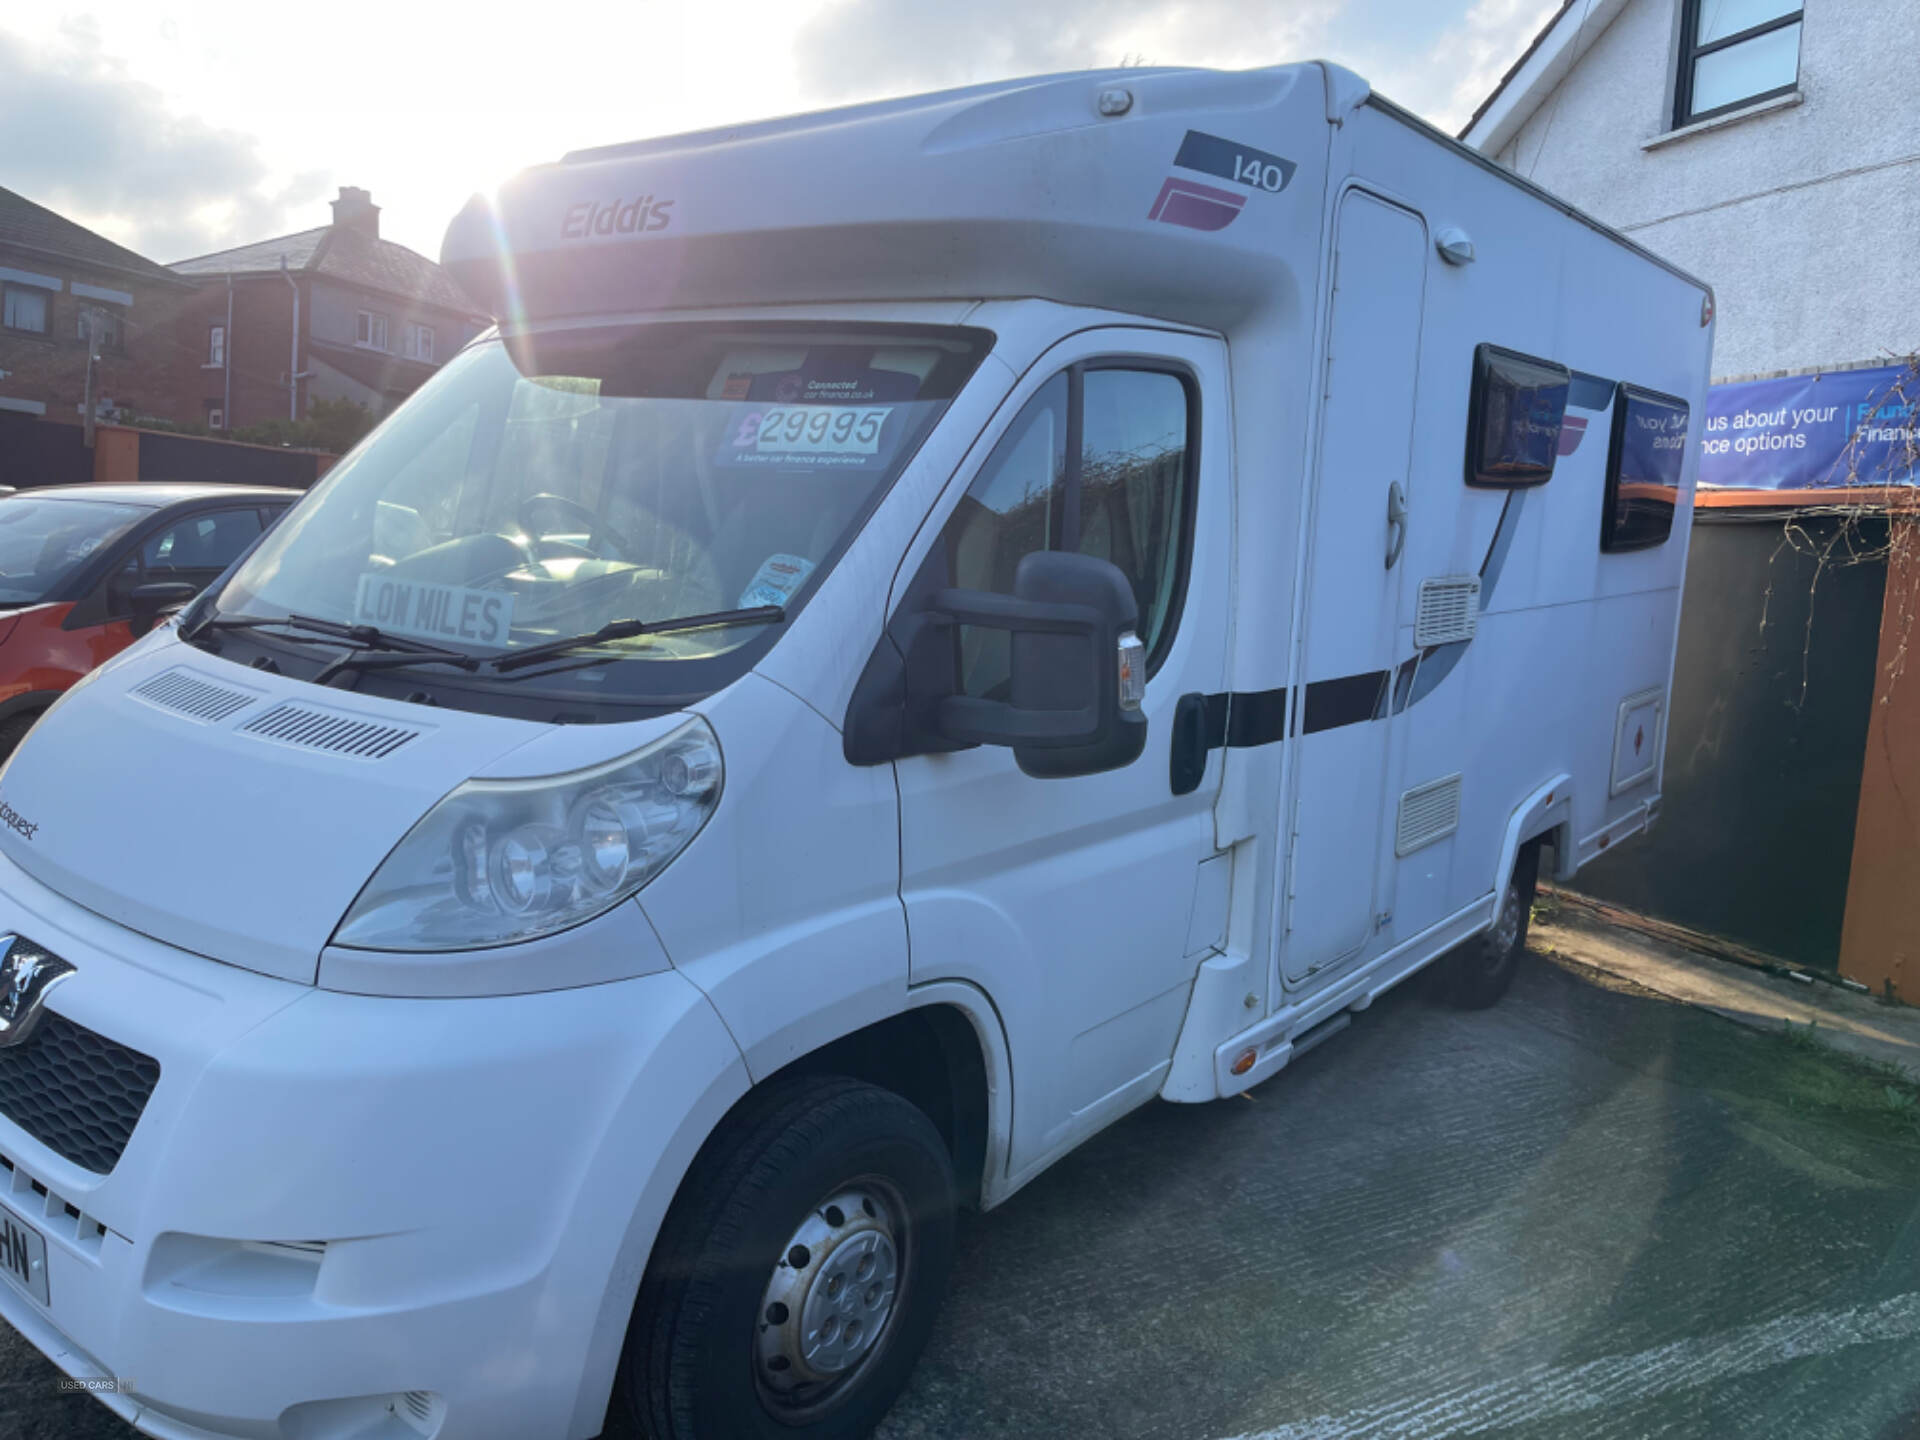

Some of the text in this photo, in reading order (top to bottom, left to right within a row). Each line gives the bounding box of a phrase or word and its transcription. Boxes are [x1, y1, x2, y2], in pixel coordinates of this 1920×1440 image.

[1232, 154, 1283, 192] 140
[560, 195, 675, 239] Elddis
[807, 379, 858, 390] Connected
[1707, 415, 1729, 432] us
[1733, 408, 1787, 430] about
[1791, 406, 1838, 429] your
[1734, 431, 1807, 456] options
[743, 454, 769, 463] better
[785, 454, 816, 464] finance
[817, 455, 867, 466] experience
[414, 587, 502, 642] MILES
